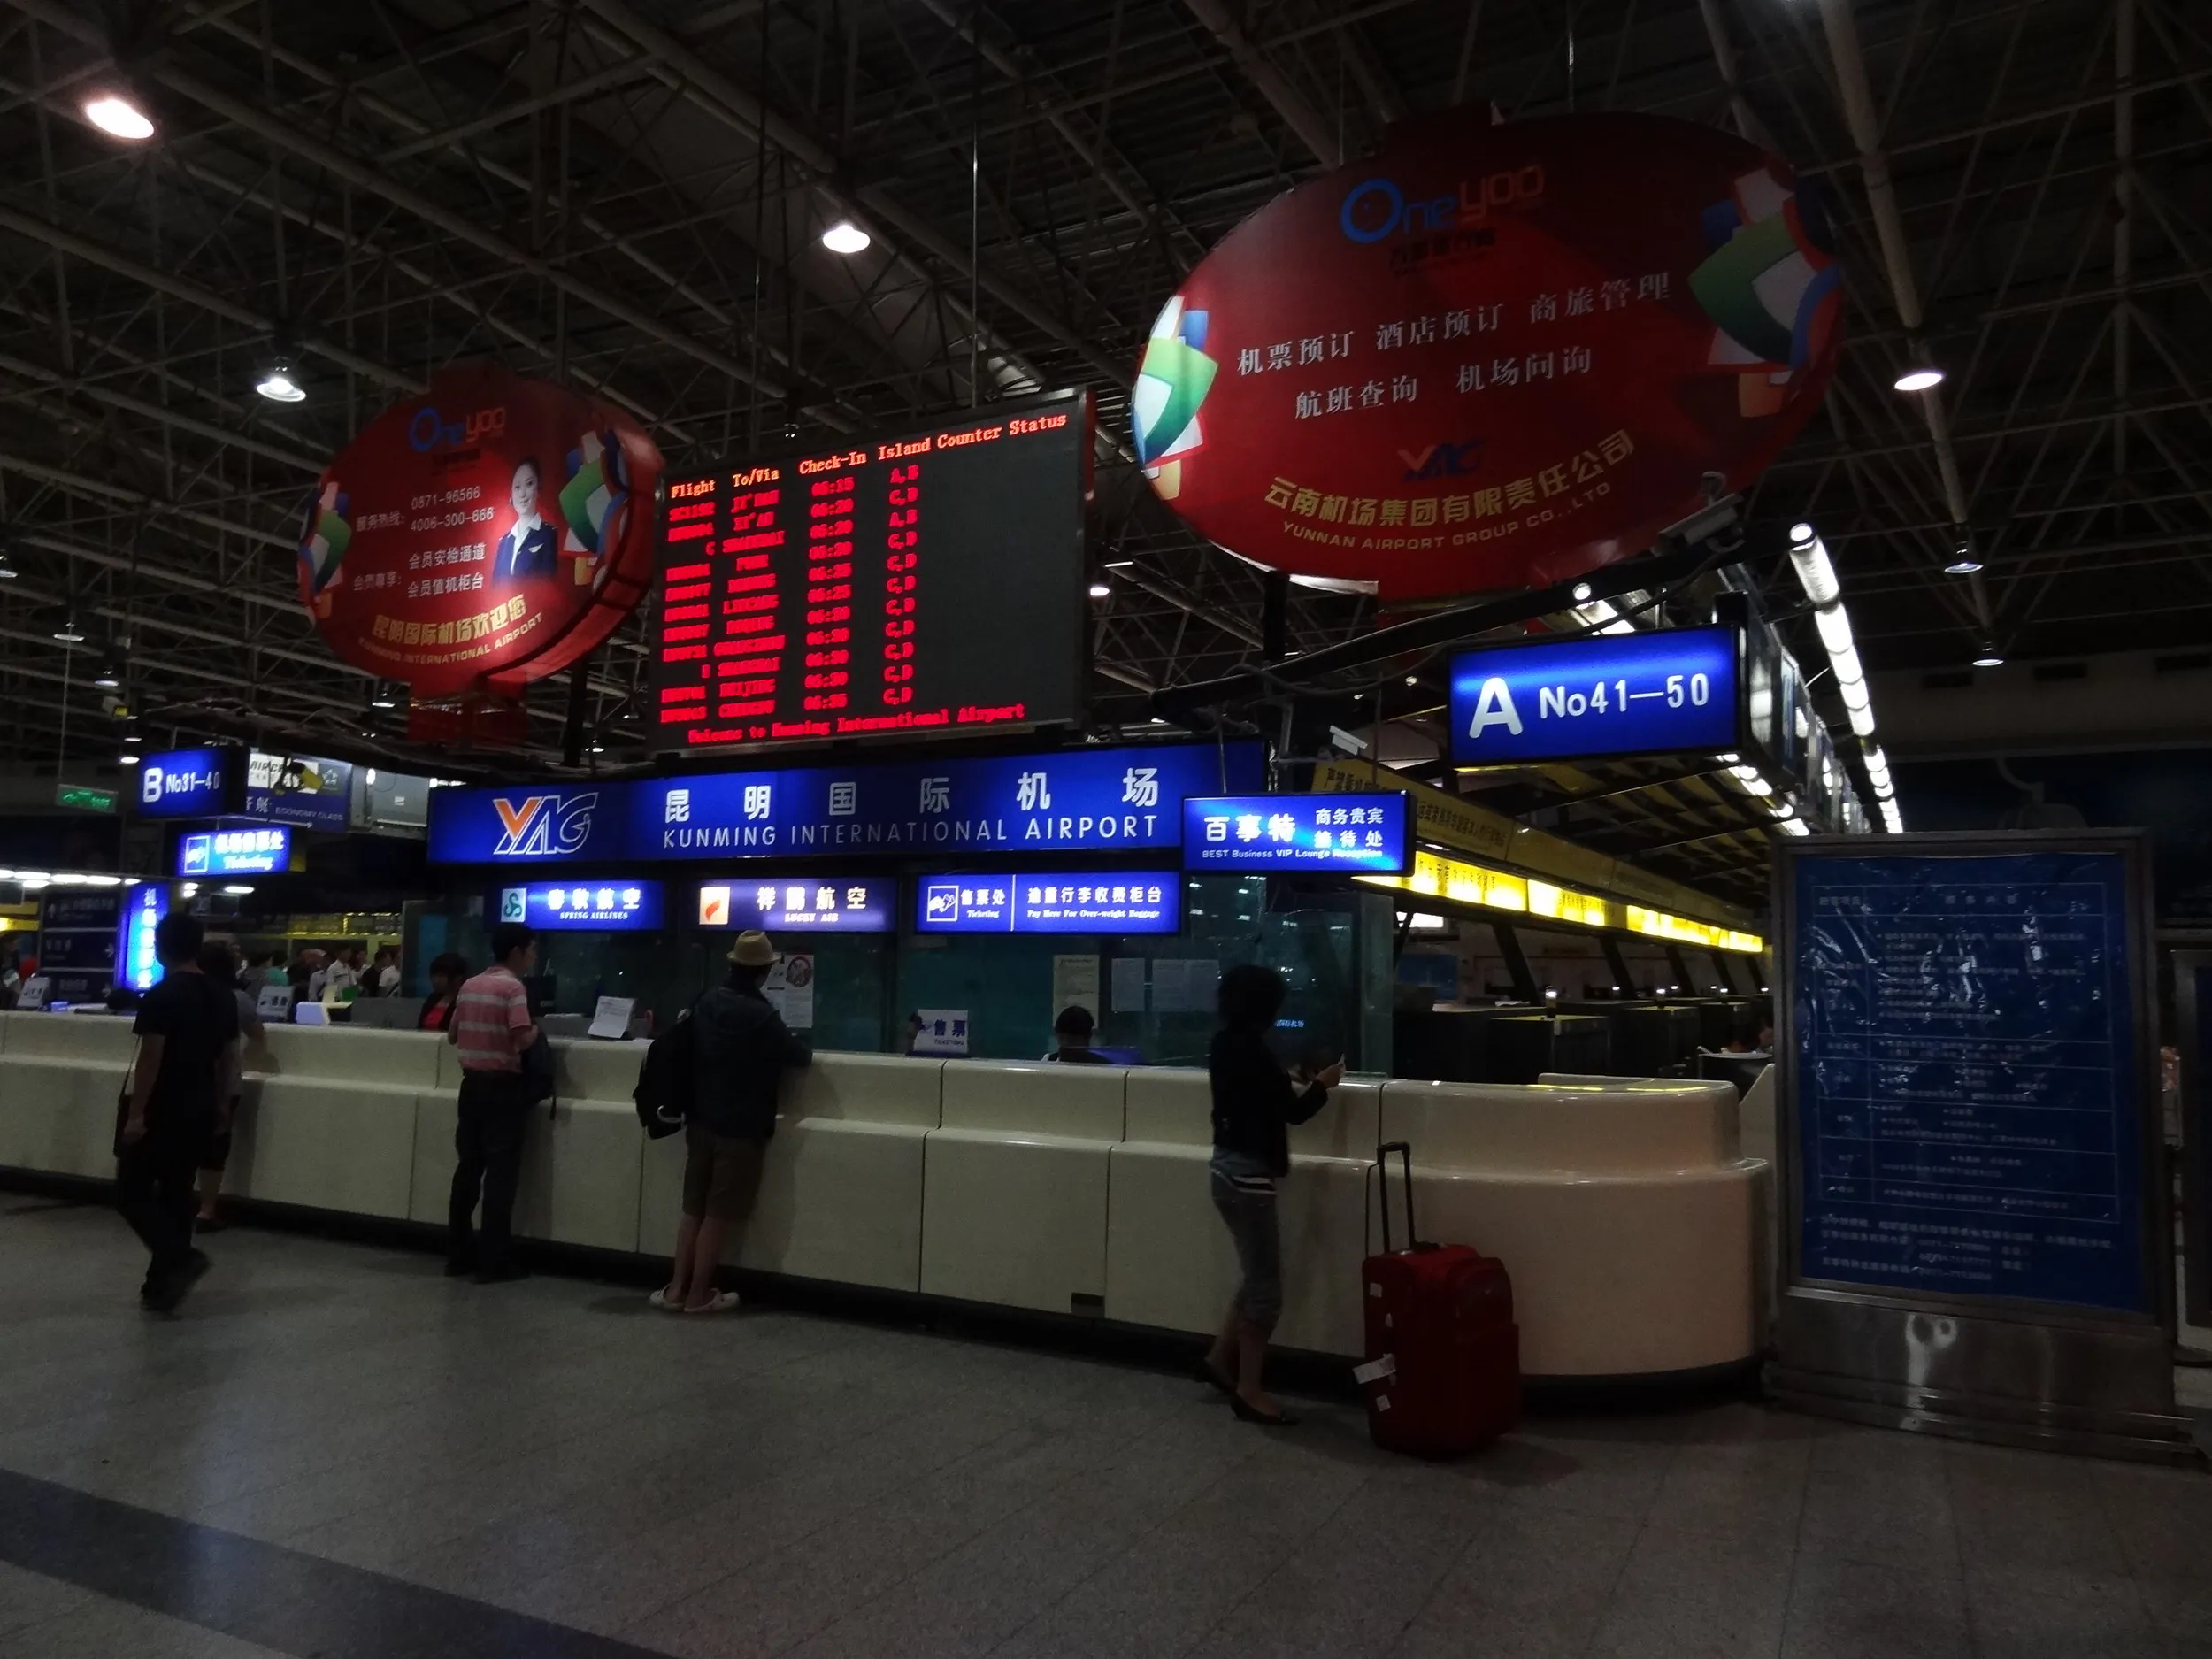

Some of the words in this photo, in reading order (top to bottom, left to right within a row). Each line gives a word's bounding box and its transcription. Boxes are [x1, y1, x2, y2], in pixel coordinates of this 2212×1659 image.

[1237, 330, 1355, 376] 机票预订
[1376, 303, 1503, 350] 酒店预订
[1531, 272, 1670, 325] 商旅管理
[1295, 376, 1418, 419] 航班查询
[1456, 347, 1592, 394] 机场问询
[671, 479, 716, 498] Flight
[732, 468, 780, 488] To/Via
[799, 450, 867, 474] Check-In
[878, 437, 932, 461] Island
[936, 426, 1002, 449] Counter
[1009, 414, 1067, 435] Status
[1263, 429, 1635, 527] 云南机场集团有限责任公司
[411, 506, 495, 532] 4006-300-666
[1282, 521, 1356, 549] YUNNAN
[1362, 535, 1445, 550] AIRPORT
[1452, 520, 1518, 546] GROUP
[409, 542, 487, 570] 会员安检通道
[407, 572, 484, 598] 会员值机柜台
[402, 643, 491, 665] INTERNATIONAL
[494, 611, 543, 650] AIRPORT
[957, 703, 1025, 723] Airport
[1468, 676, 1524, 739] A
[142, 767, 163, 803] B
[664, 767, 1159, 823] 昆明国际机场
[664, 826, 776, 849] KUNMING
[791, 818, 1007, 846] INTERNATIONAL
[1025, 815, 1157, 840] AIRPORT
[1204, 813, 1296, 842] 百事特
[1316, 807, 1384, 826] 商务贵宾
[1202, 849, 1229, 858] BEST
[1232, 849, 1272, 858] Business
[1276, 849, 1292, 857] VIP
[1295, 849, 1330, 860] Lounge
